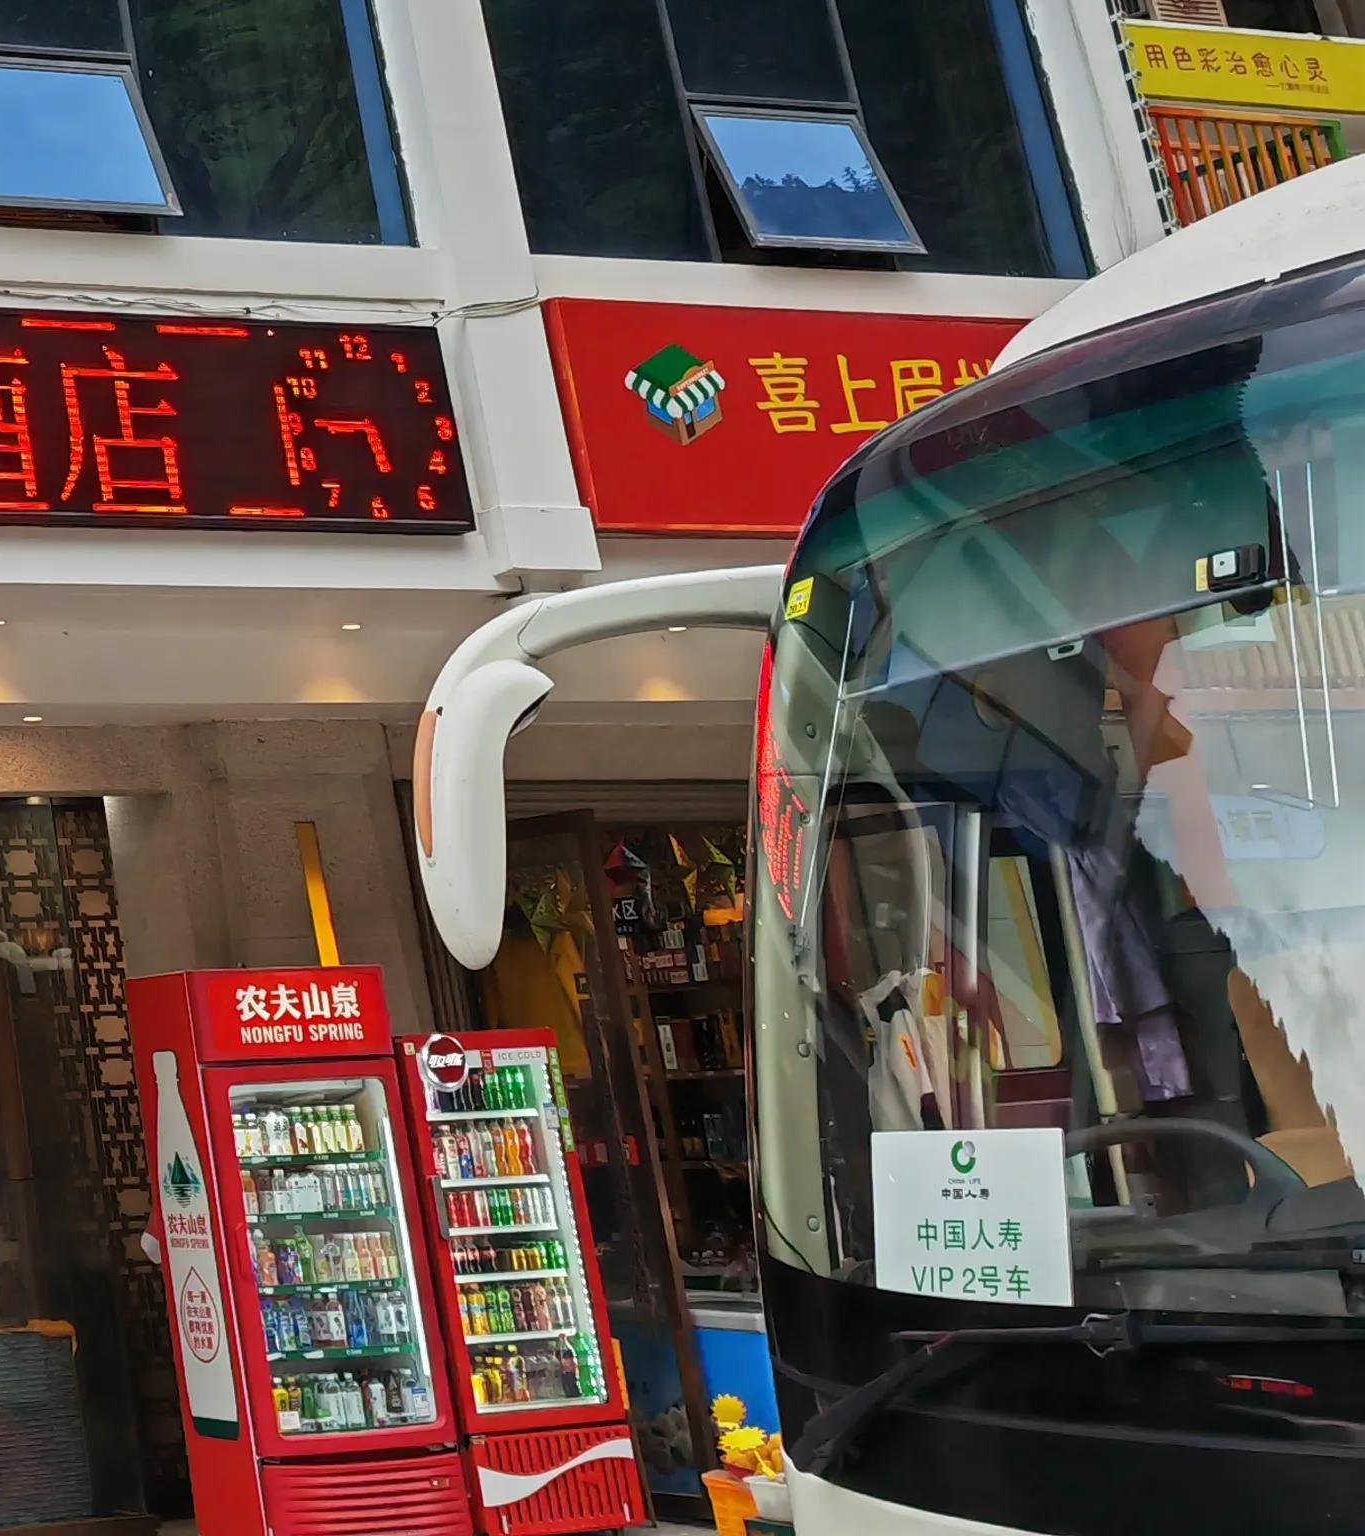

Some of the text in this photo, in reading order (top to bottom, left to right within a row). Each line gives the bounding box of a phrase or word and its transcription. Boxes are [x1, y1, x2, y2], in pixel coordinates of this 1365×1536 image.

[1144, 44, 1328, 83] 用色彩治愈心灵
[339, 334, 371, 360] 12
[286, 376, 317, 399] 10
[415, 380, 434, 403] 2
[321, 483, 340, 507] 7
[235, 982, 361, 1022] 农夫山泉
[240, 1022, 364, 1044] NONGFU SPRING
[498, 1052, 513, 1061] ICE
[516, 1050, 542, 1060] COLD
[941, 1188, 990, 1200] 中国人寿
[167, 1212, 207, 1236] 农夫山泉
[917, 1218, 1023, 1251] 中国人寿
[911, 1265, 1031, 1299] VIP 2号车
